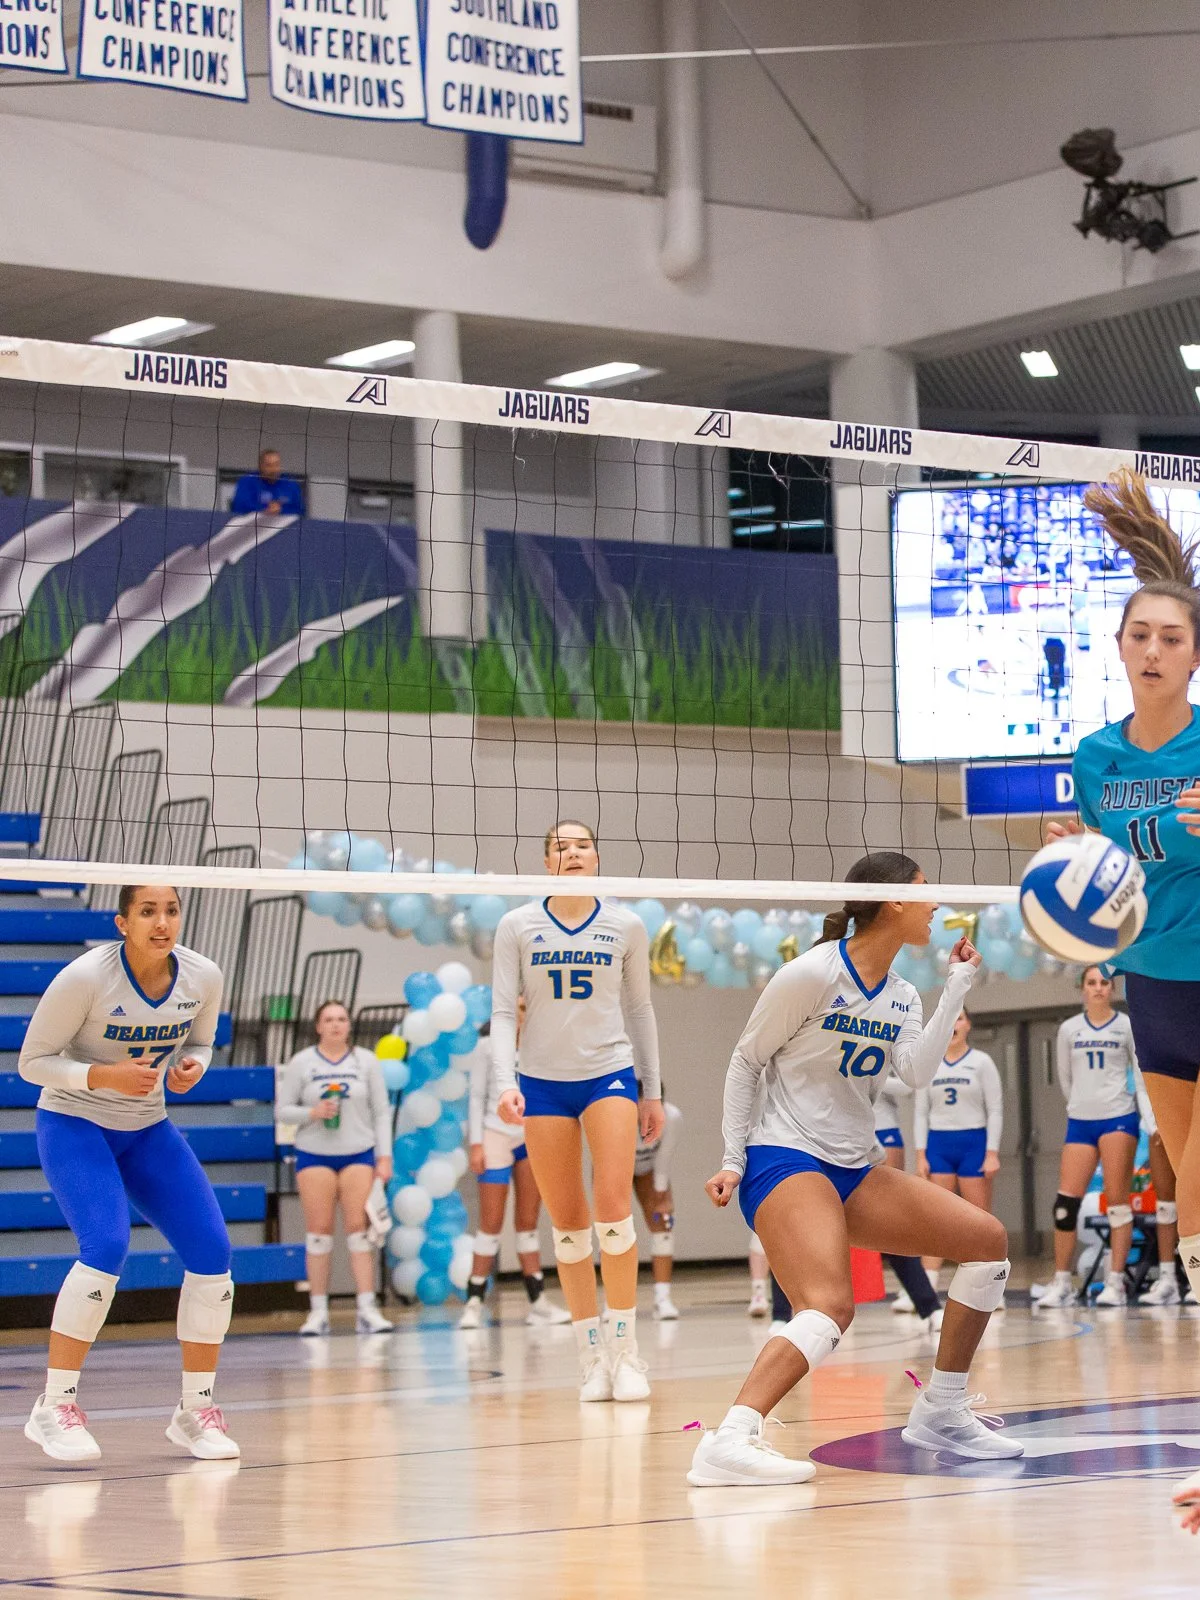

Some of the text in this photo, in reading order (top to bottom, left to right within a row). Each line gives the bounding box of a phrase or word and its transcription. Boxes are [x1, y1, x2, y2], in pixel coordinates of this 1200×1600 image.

[278, 16, 412, 66] CONFERENCE
[447, 32, 566, 77] CONFERENCE
[102, 35, 229, 86] CHAMPIONS
[285, 63, 405, 109] CHAMPIONS
[443, 81, 570, 125] CHAMPIONS
[125, 353, 228, 389] JAGUARS
[499, 391, 590, 425] JAGUARS
[830, 424, 912, 456] JAGUARS
[1055, 772, 1074, 804] D
[1126, 816, 1166, 862] 11
[530, 950, 613, 967] BEARCATS
[547, 969, 594, 1000] 15
[103, 1018, 193, 1042] BEARCAT
[821, 1012, 902, 1043] BEARCAT
[838, 1040, 886, 1078] 10
[1086, 1051, 1104, 1069] 11
[944, 1088, 957, 1105] 3
